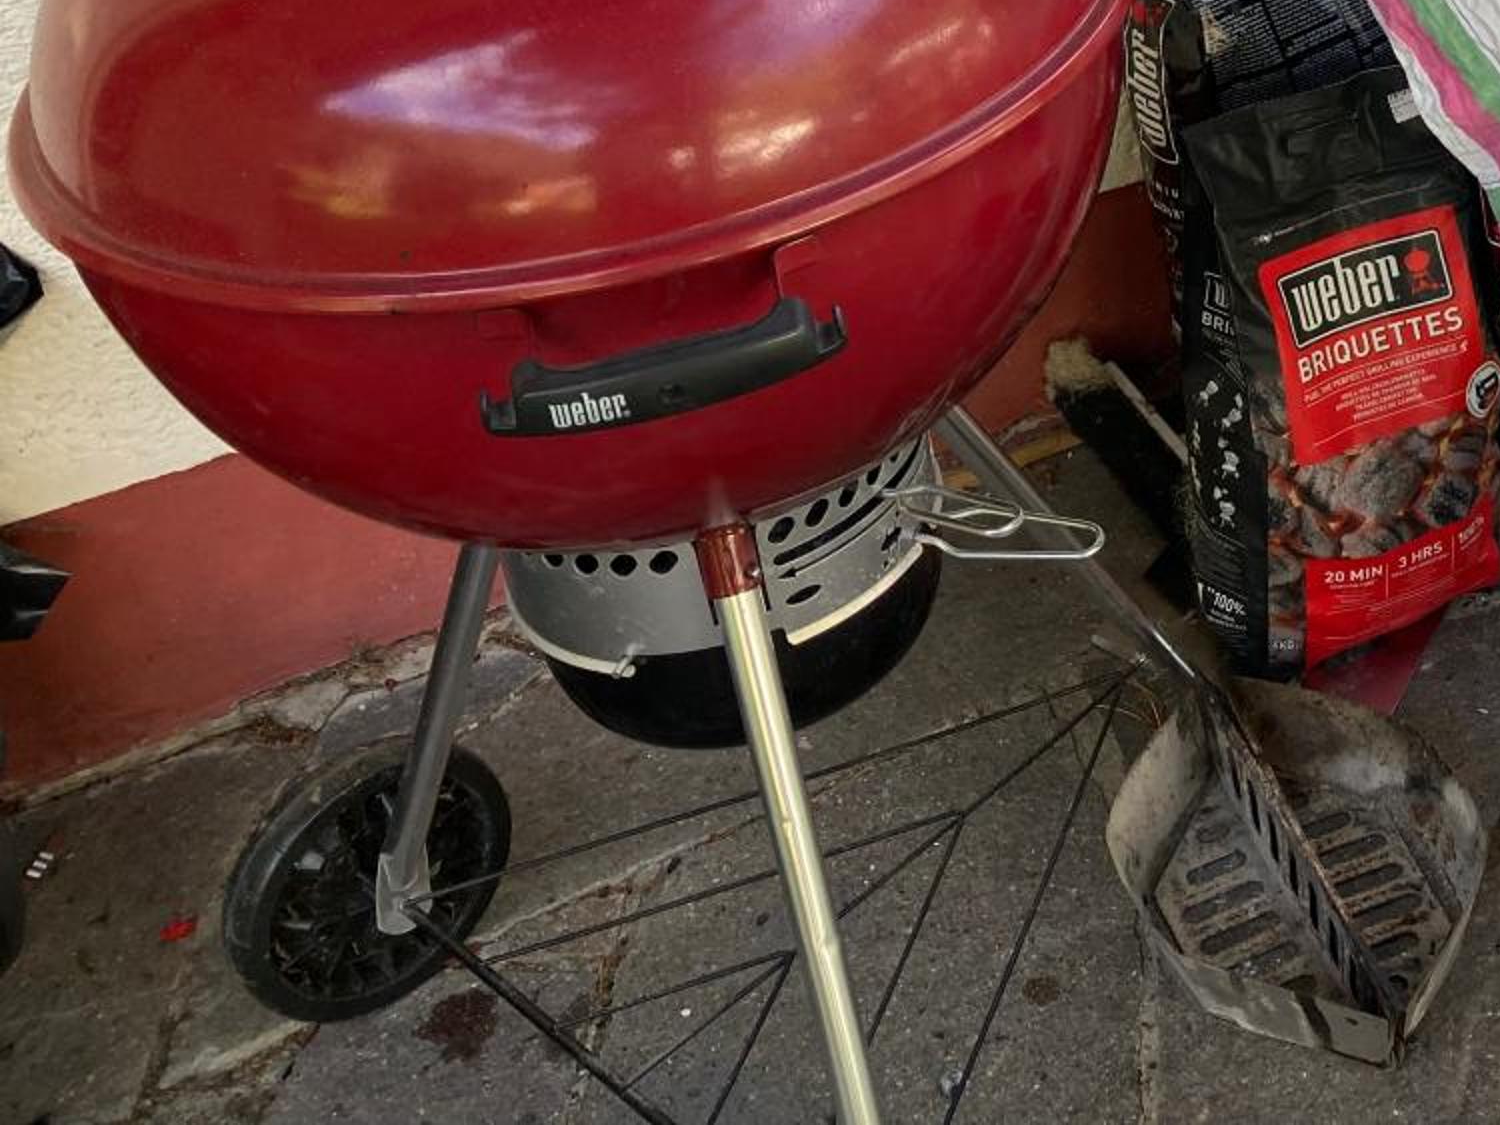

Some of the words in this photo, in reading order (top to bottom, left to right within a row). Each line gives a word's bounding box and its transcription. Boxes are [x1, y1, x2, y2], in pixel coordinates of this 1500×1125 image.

[1290, 254, 1401, 332] weber
[1298, 306, 1464, 384] BRIQUETTES
[548, 392, 626, 428] weber
[1398, 556, 1407, 568] 3
[1411, 541, 1444, 565] HRS
[1324, 570, 1345, 584] 20
[1350, 564, 1384, 582] MIN
